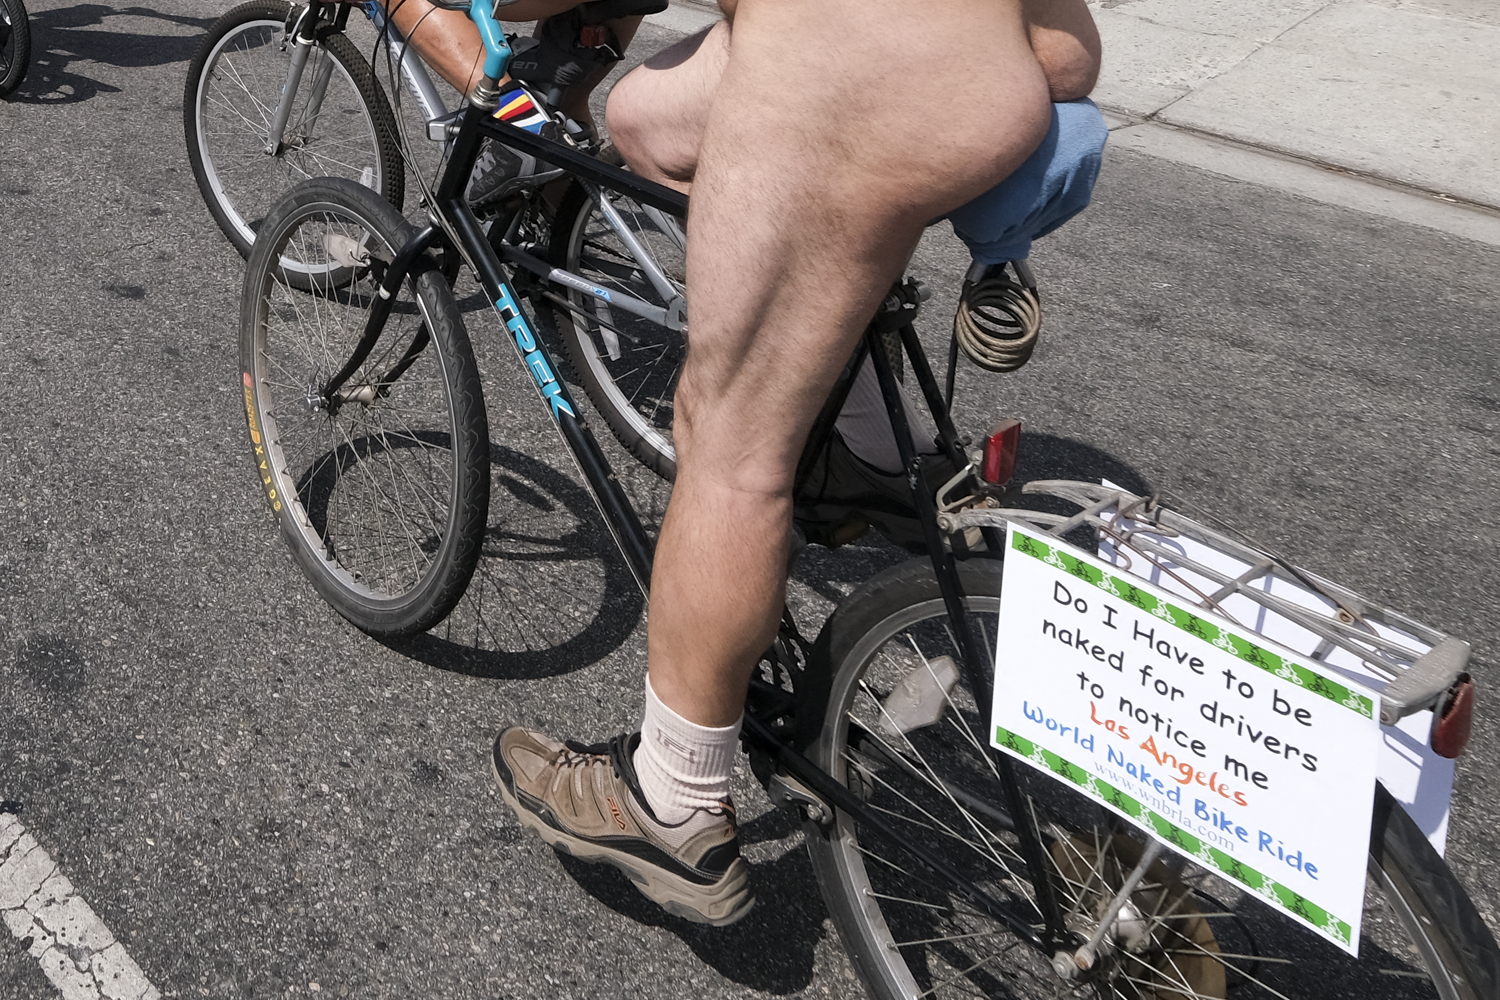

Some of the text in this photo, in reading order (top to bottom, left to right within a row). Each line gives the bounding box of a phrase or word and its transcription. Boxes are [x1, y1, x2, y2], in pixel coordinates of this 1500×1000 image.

[495, 282, 576, 422] TREK
[254, 444, 277, 500] GEAX
[1042, 619, 1318, 772] naked for drivers
[1053, 580, 1312, 727] Do I Have to be
[1023, 700, 1319, 880] World Naked Bike Ride
[1076, 670, 1269, 790] to notice me
[1139, 734, 1249, 807] Angeles
[1094, 761, 1235, 852] www.wnbrla.com
